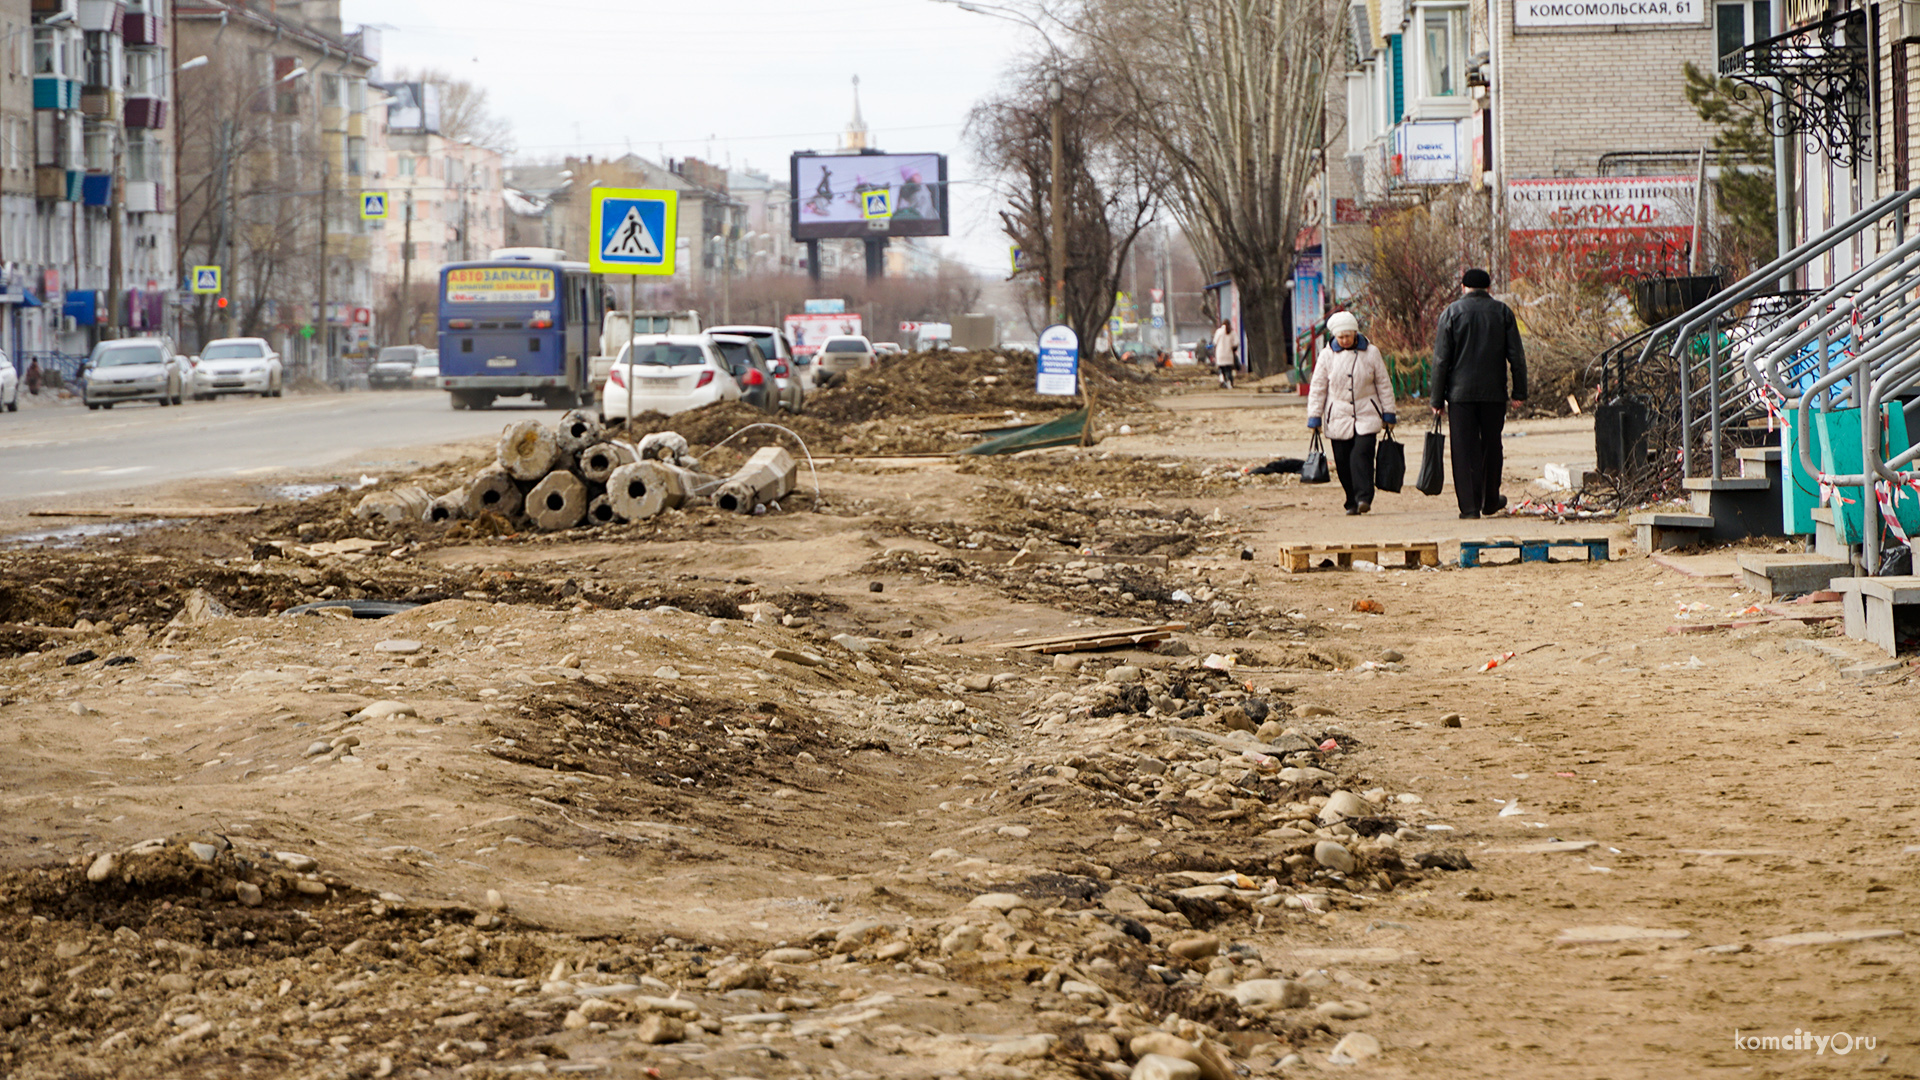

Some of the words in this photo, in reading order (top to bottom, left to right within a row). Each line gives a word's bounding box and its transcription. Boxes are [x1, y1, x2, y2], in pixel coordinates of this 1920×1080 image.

[1530, 3, 1672, 16] КОМСОМОЛЬСКАЯ,
[1676, 2, 1691, 13] 61
[1513, 188, 1624, 201] ОСЕТИНСКИЕ
[449, 270, 551, 282] АВТОЗАПЧАСТИ
